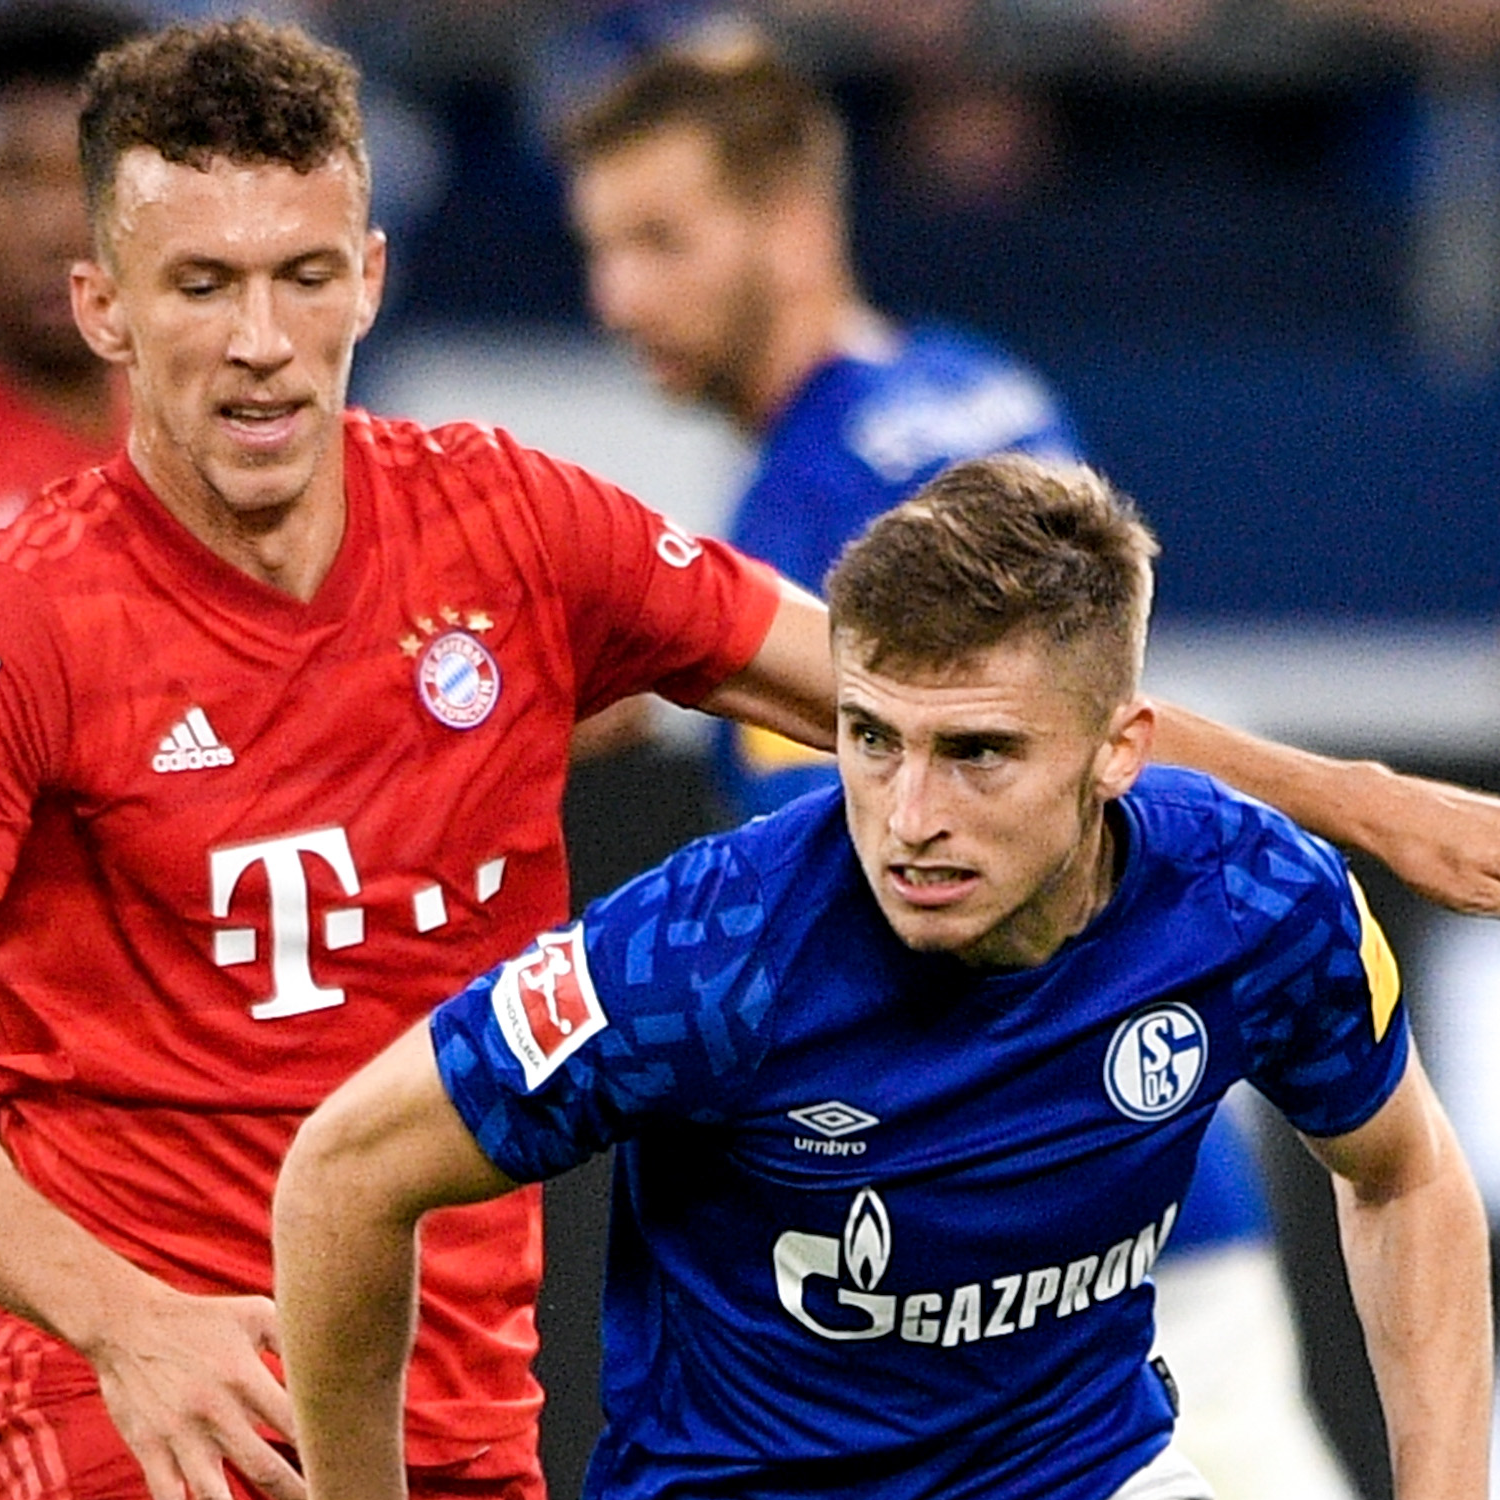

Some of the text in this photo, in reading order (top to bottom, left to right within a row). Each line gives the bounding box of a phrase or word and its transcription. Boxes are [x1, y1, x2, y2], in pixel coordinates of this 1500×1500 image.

[152, 746, 235, 773] adidas
[210, 826, 364, 1019] T
[794, 1136, 867, 1156] umbro
